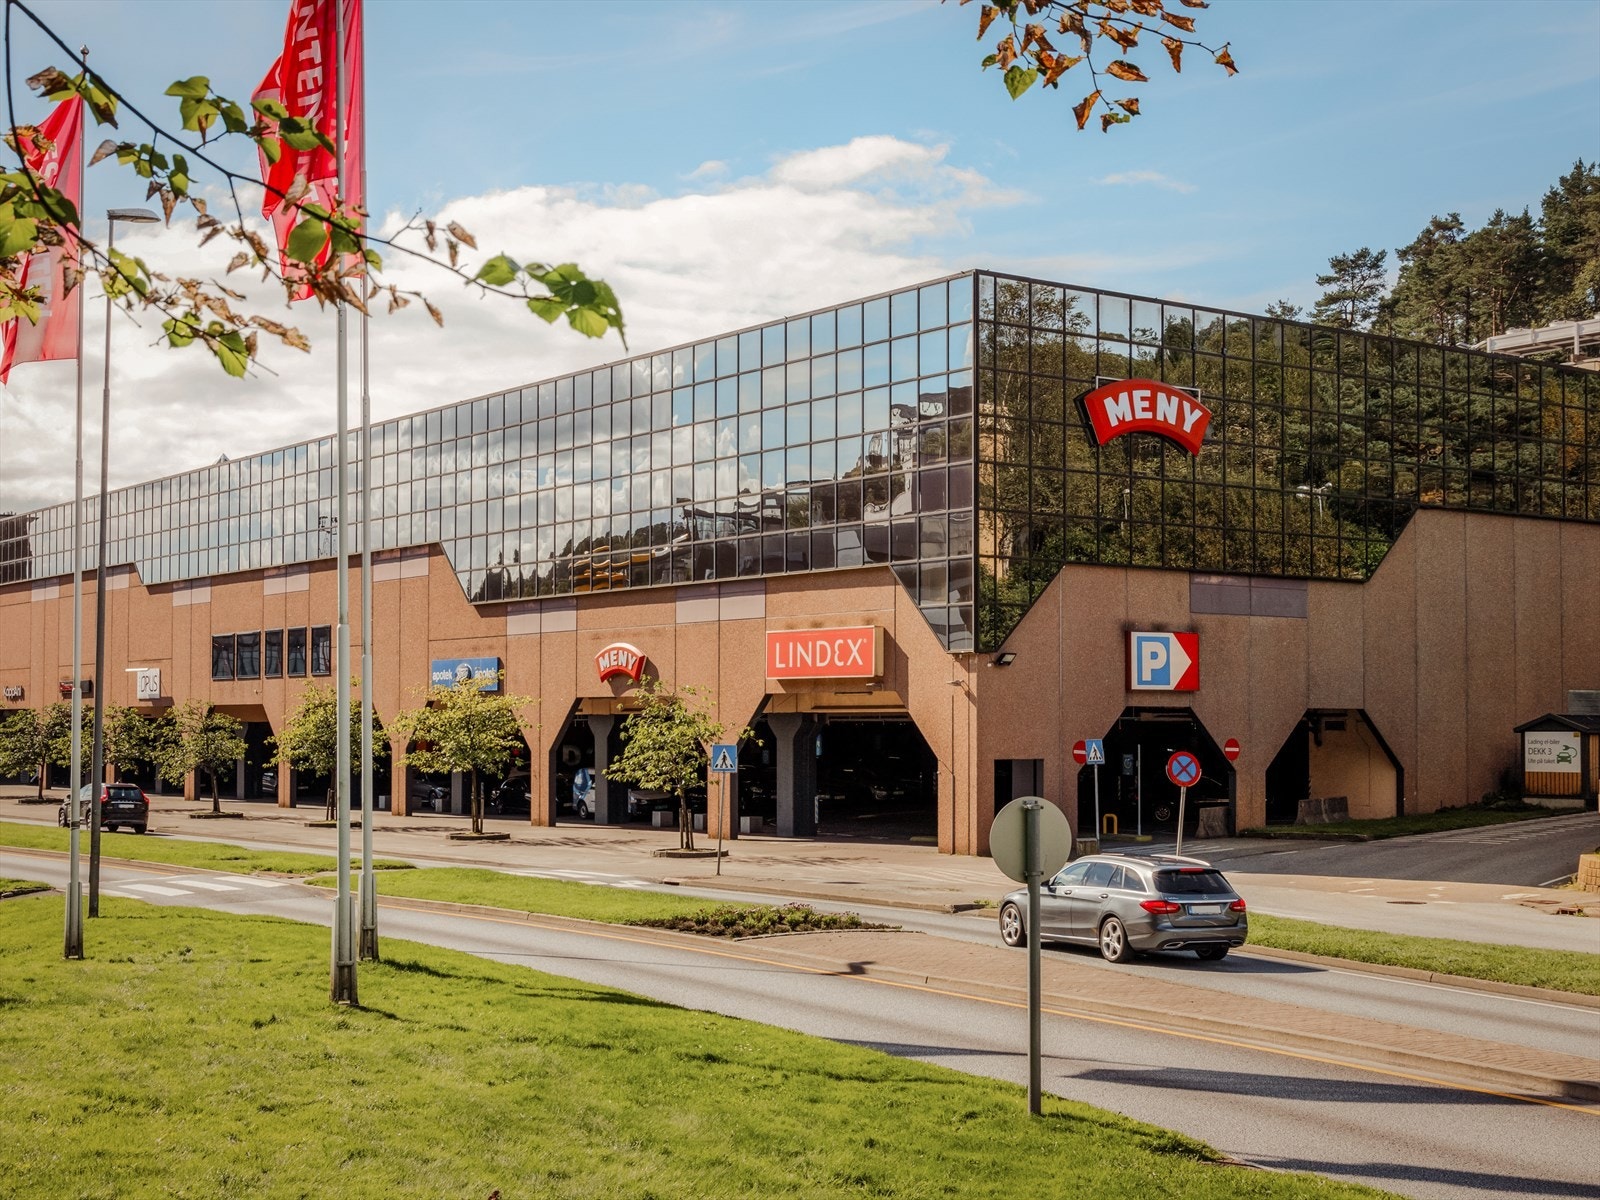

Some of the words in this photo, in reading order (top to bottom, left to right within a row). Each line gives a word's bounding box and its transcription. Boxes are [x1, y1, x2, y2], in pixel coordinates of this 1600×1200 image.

[296, 0, 325, 132] NTEN
[1103, 389, 1203, 433] MENY
[598, 649, 637, 672] MENY
[775, 638, 864, 668] LINDEX
[1141, 641, 1167, 681] P
[141, 675, 158, 692] OPUS
[432, 668, 453, 682] apotek
